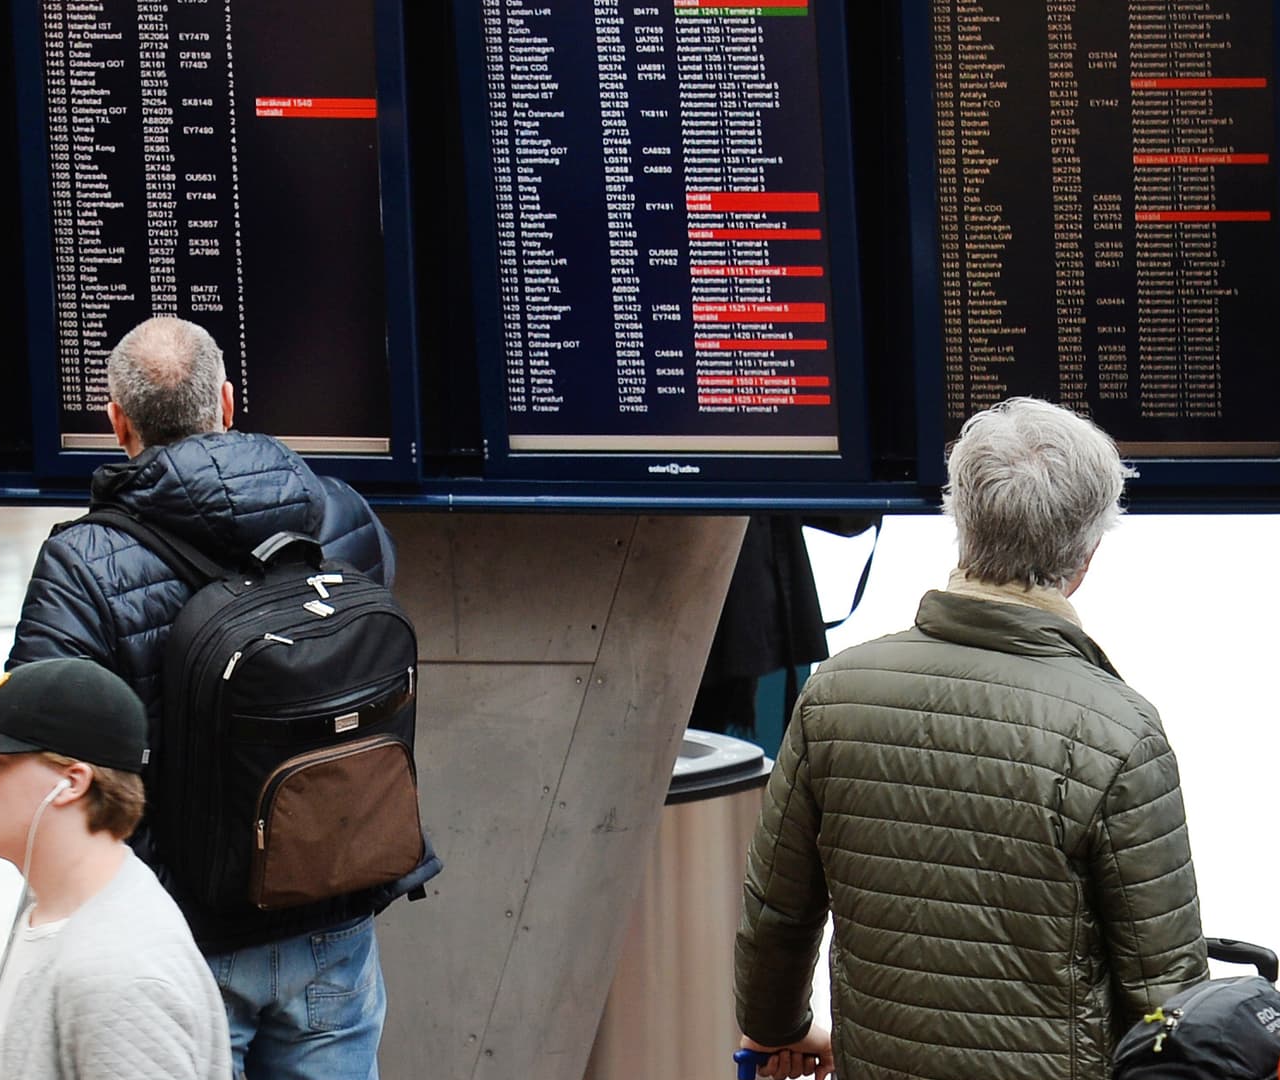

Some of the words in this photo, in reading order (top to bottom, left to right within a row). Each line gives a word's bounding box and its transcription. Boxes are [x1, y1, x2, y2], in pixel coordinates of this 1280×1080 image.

[98, 22, 112, 30] IST
[509, 45, 555, 54] Copenhagen
[106, 60, 125, 68] GOT
[109, 107, 128, 115] GOT
[72, 135, 95, 143] Visby
[79, 265, 98, 273] Oslo
[526, 304, 571, 312] Copenhagen
